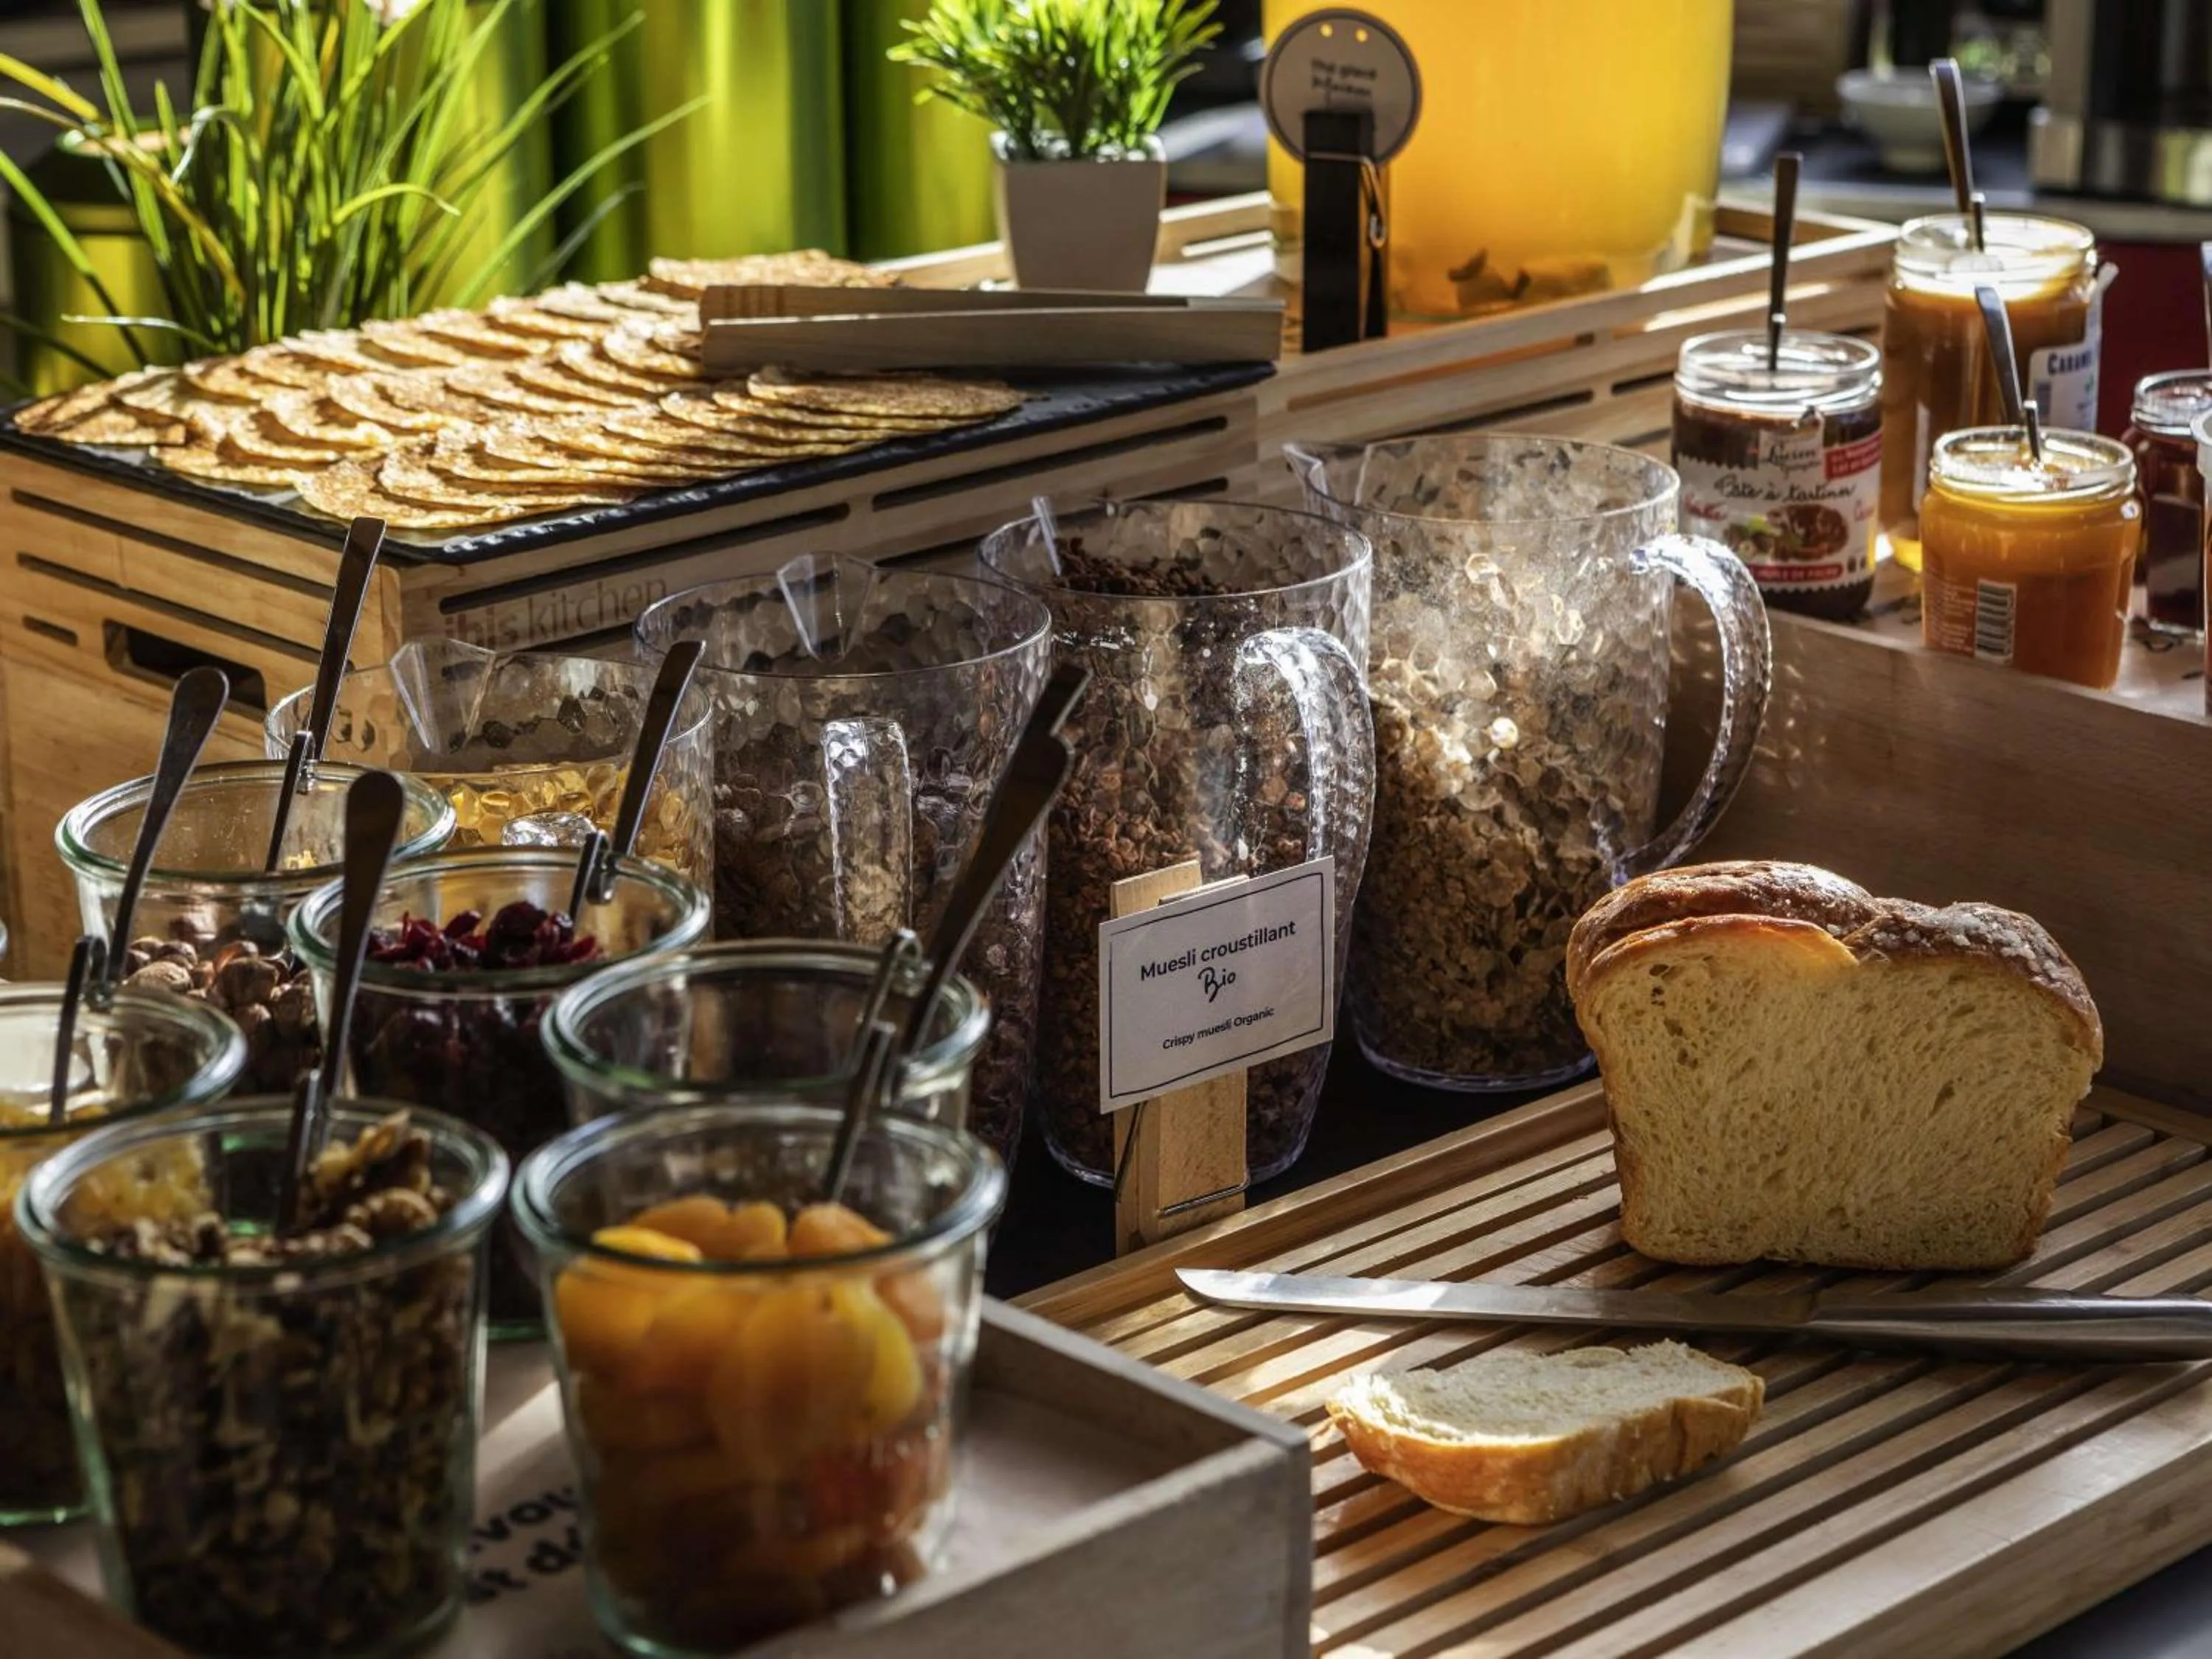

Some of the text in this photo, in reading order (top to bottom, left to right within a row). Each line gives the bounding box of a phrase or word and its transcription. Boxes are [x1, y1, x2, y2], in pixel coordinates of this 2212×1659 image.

[527, 577, 667, 643] kitchen
[1139, 920, 1296, 981] Muesli croustillant
[1197, 965, 1237, 1004] Bio
[1162, 1006, 1275, 1050] Crispy muesli Organic
